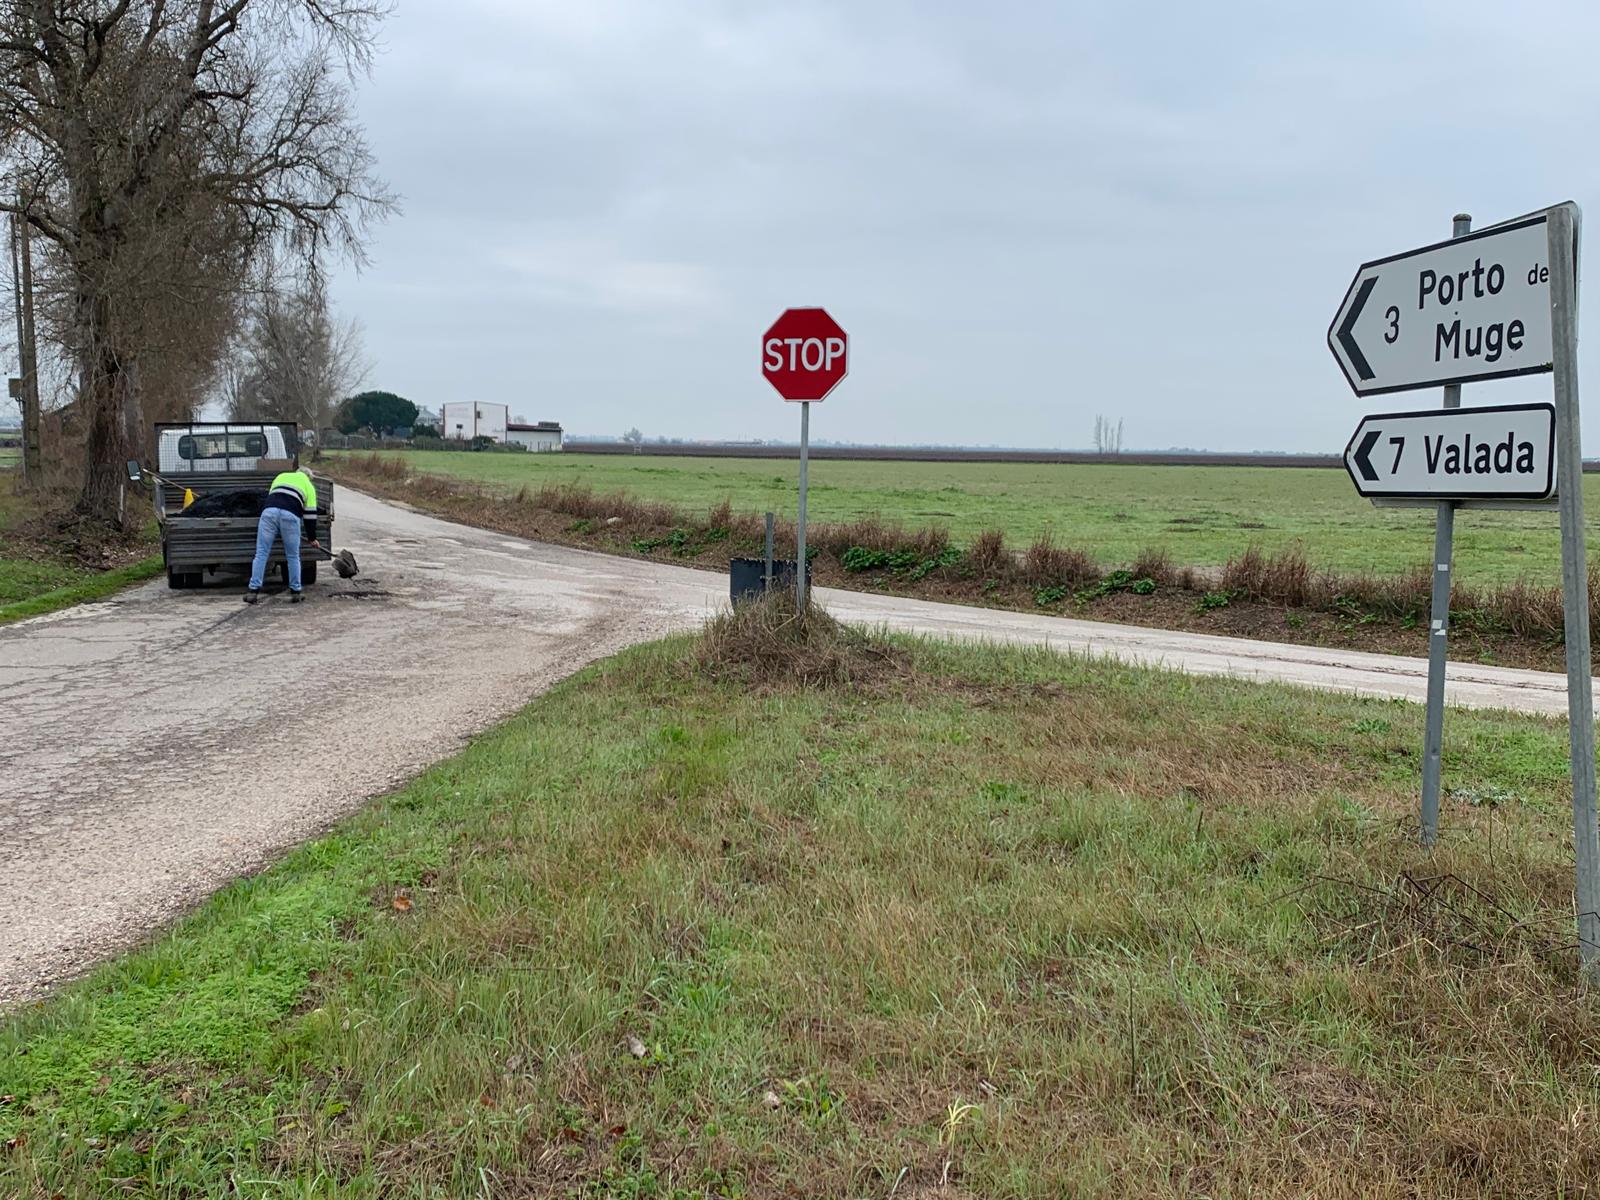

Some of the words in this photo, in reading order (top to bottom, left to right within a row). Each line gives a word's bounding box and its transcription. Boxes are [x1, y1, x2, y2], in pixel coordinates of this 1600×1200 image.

[1418, 257, 1505, 310] Porto
[1527, 263, 1549, 286] de
[1384, 305, 1400, 344] 3
[1434, 319, 1525, 363] Muge
[764, 337, 846, 372] STOP
[1389, 436, 1405, 475] 7
[1424, 431, 1534, 475] Valada
